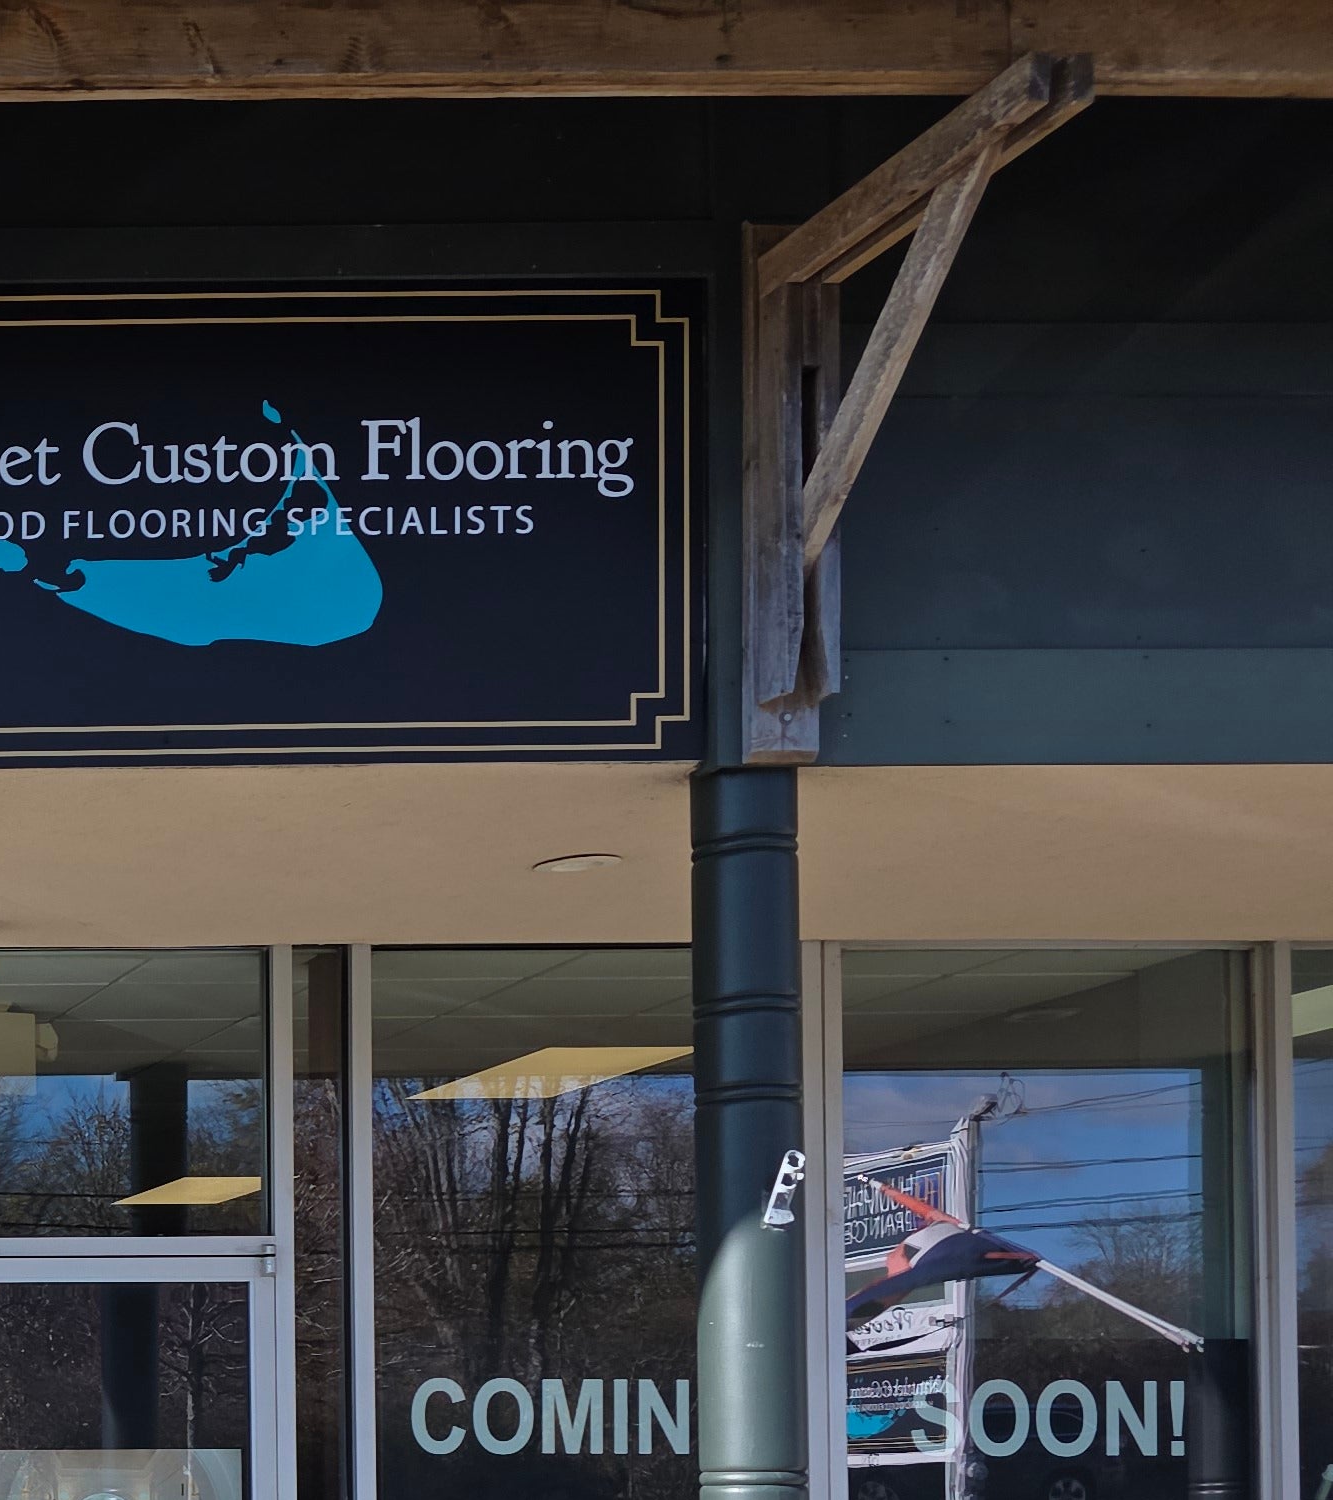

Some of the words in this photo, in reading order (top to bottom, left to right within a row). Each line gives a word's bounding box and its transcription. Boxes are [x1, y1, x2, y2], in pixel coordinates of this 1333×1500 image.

[81, 421, 340, 486] Custom
[361, 417, 636, 498] Flooring
[62, 508, 268, 540] FLOORING
[286, 504, 536, 538] SPECIALISTS
[411, 1377, 690, 1456] COMIN
[911, 1379, 1186, 1457] SOON!
